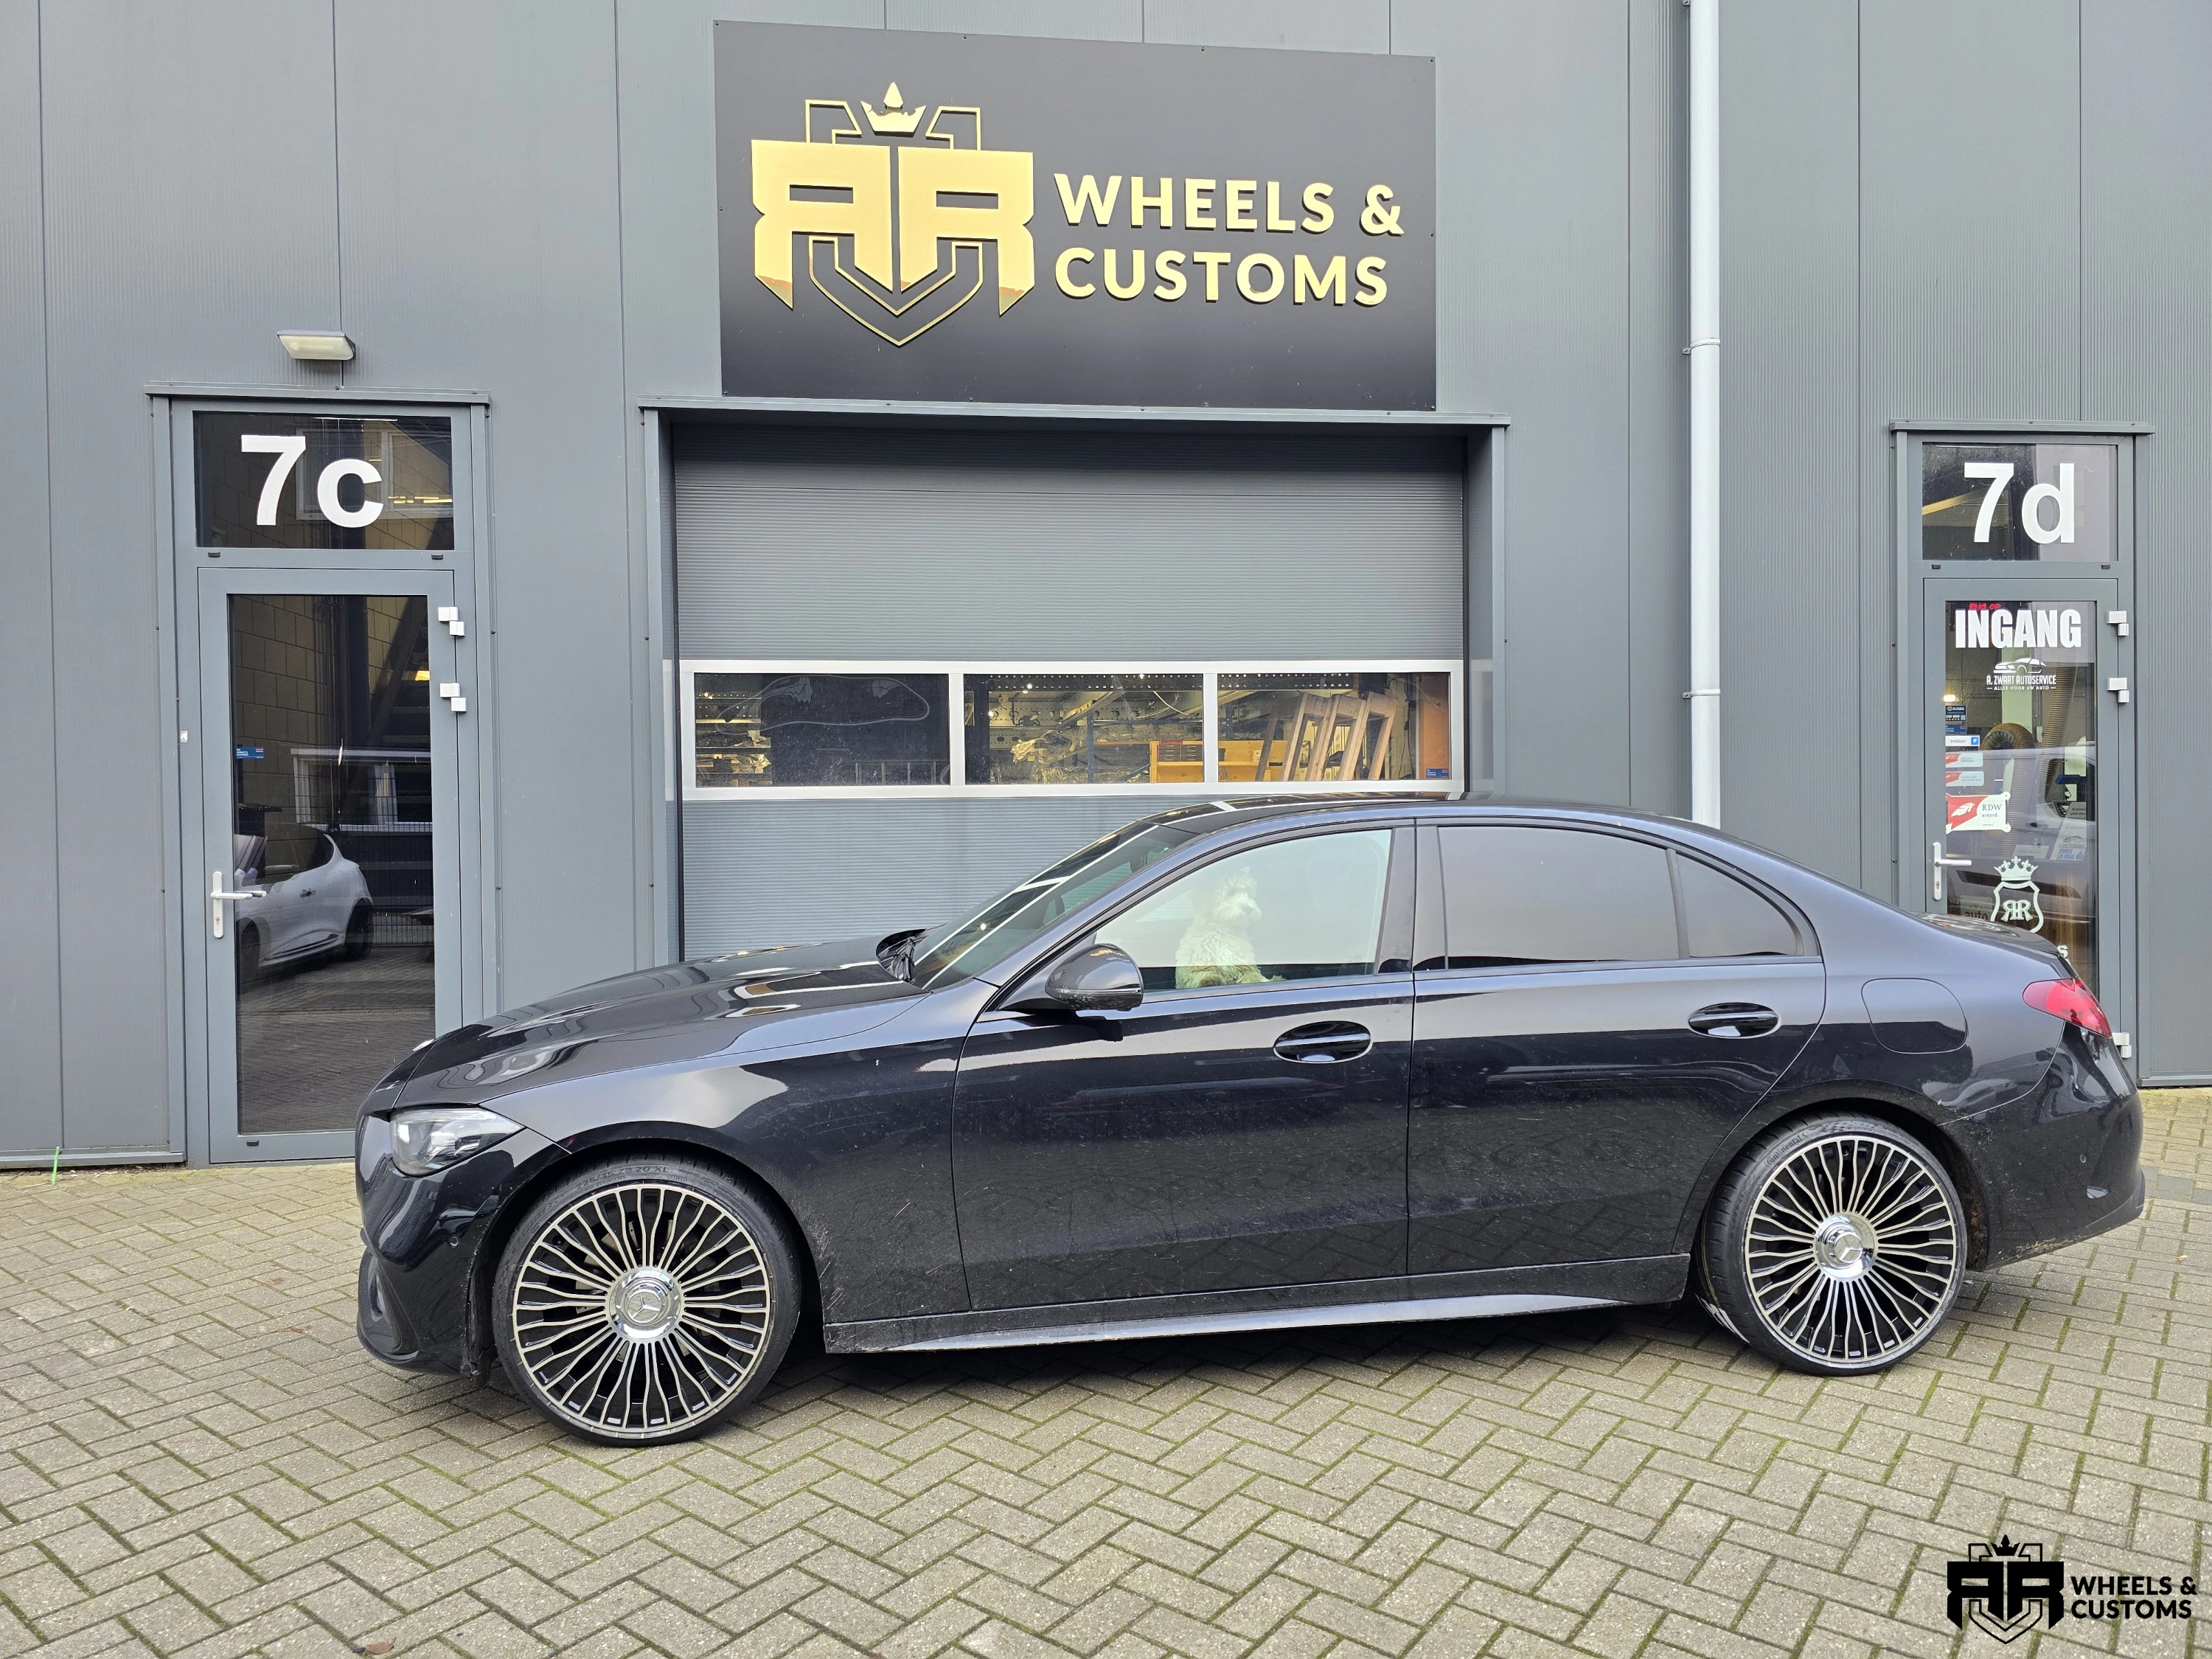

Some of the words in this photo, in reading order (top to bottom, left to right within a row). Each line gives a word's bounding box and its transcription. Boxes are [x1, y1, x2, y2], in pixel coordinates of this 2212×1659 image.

[1054, 173, 1335, 233] WHEELS
[1360, 184, 1405, 235] &
[1054, 247, 1388, 306] CUSTOMS
[240, 434, 384, 529] 7c
[1964, 462, 2075, 544] 7d
[1955, 609, 2081, 649] INGANG
[1994, 675, 2015, 685] ZWART
[2016, 675, 2056, 685] AUTOSERVICE
